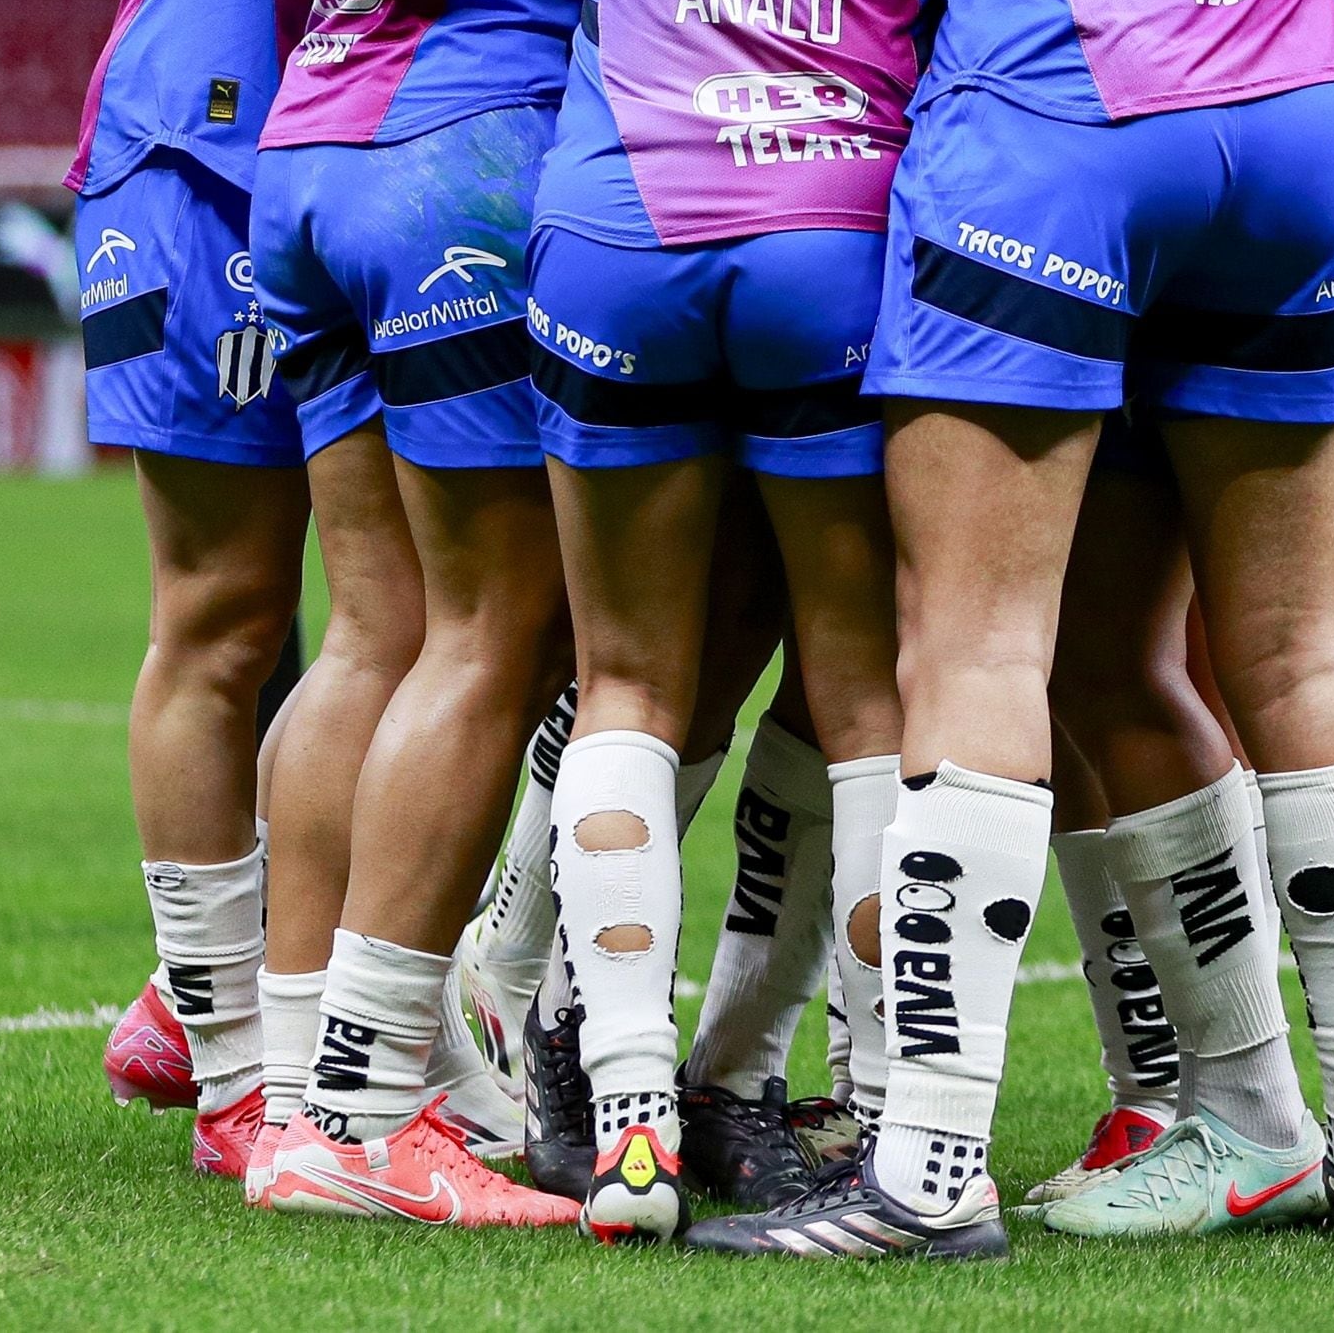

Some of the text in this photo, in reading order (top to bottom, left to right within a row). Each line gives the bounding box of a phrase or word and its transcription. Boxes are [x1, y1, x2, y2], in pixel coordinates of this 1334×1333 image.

[957, 222, 1125, 306] TACOS POPO'S
[374, 290, 499, 341] ArcelorMittal
[555, 322, 636, 375] POPO'S
